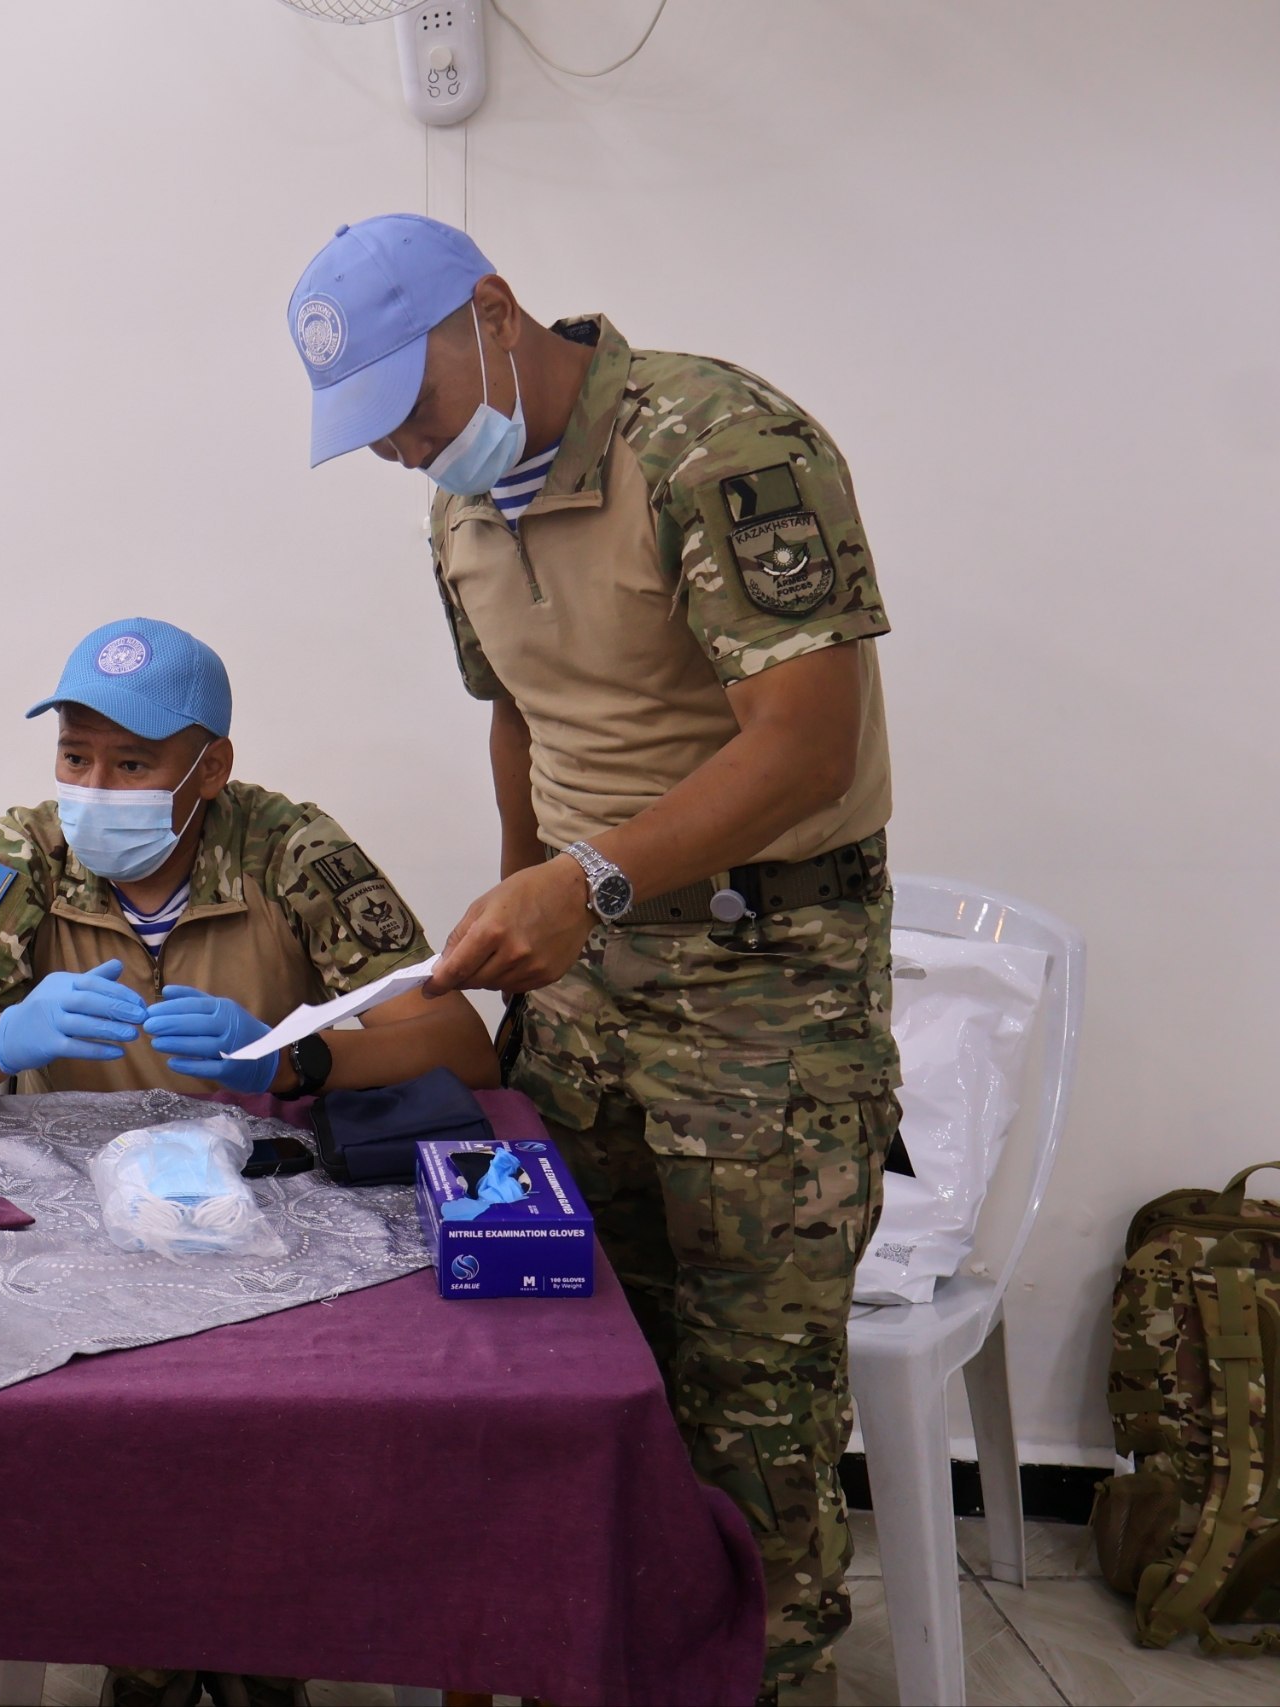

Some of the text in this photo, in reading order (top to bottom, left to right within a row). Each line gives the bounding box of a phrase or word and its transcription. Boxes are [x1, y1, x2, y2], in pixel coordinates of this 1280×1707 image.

[735, 516, 811, 544] KAZAKHSTAN
[777, 574, 809, 588] ARMED
[777, 581, 813, 596] FORCES
[342, 884, 386, 905] KAZAKHSTAN
[448, 1229, 585, 1238] NITRILE EXAMINATION GLOVES
[523, 1276, 536, 1287] M
